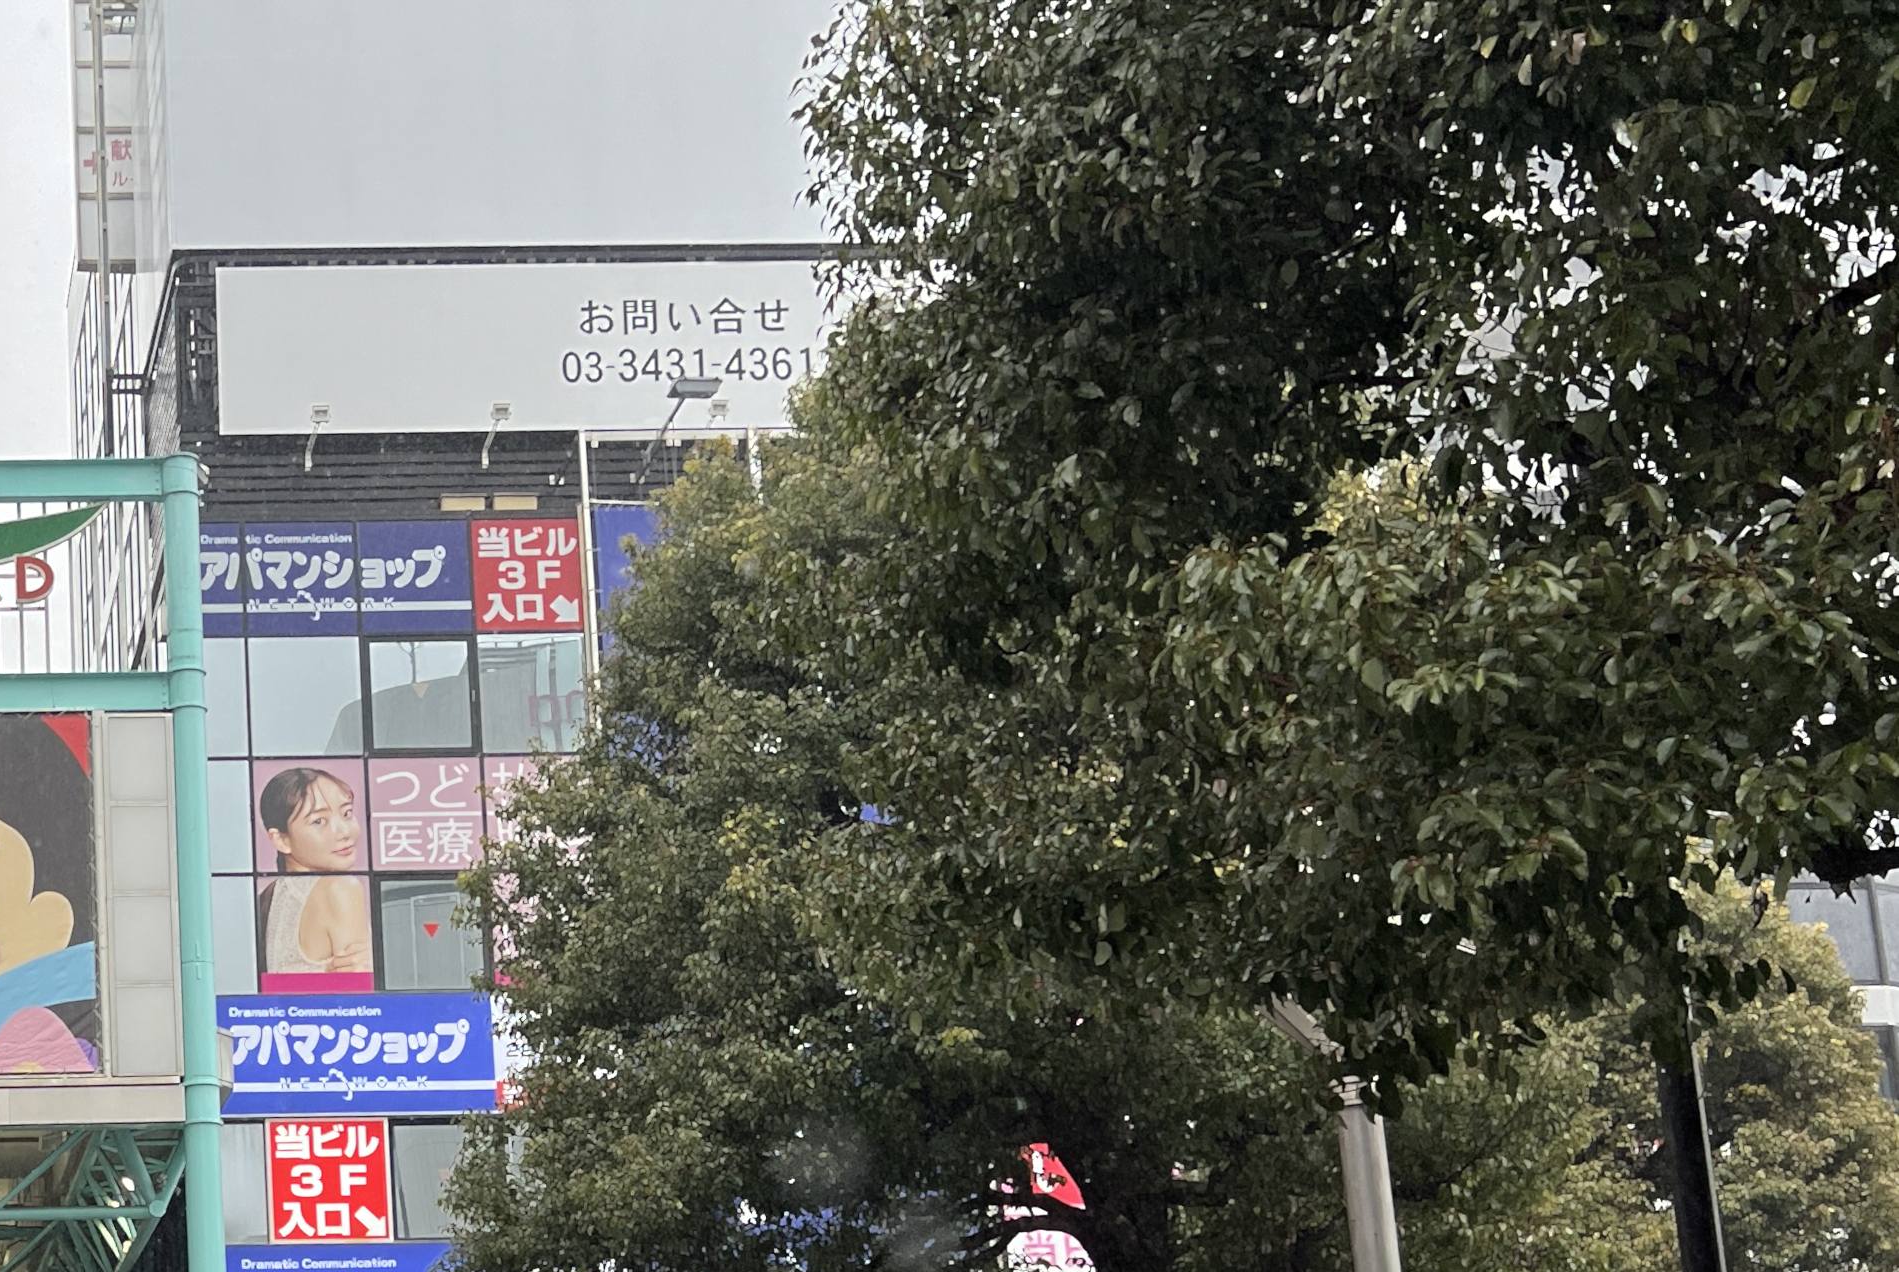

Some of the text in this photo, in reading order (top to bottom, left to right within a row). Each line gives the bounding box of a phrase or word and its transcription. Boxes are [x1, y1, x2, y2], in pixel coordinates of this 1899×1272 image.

[579, 297, 789, 335] お問い合せ
[562, 347, 812, 383] 03-3431-4361
[264, 532, 352, 545] Communication
[477, 526, 578, 558] 当ビル
[199, 545, 446, 591] アパマンショップ
[498, 560, 562, 590] 3F
[482, 593, 545, 624] 入口
[228, 1005, 382, 1018] Dramatic Communication
[230, 1018, 471, 1066] アパマンショップ
[274, 1124, 380, 1160] 当ビル
[290, 1165, 368, 1197] 3F
[278, 1202, 351, 1238] 入口
[241, 1257, 397, 1270] Dramatic Communication
